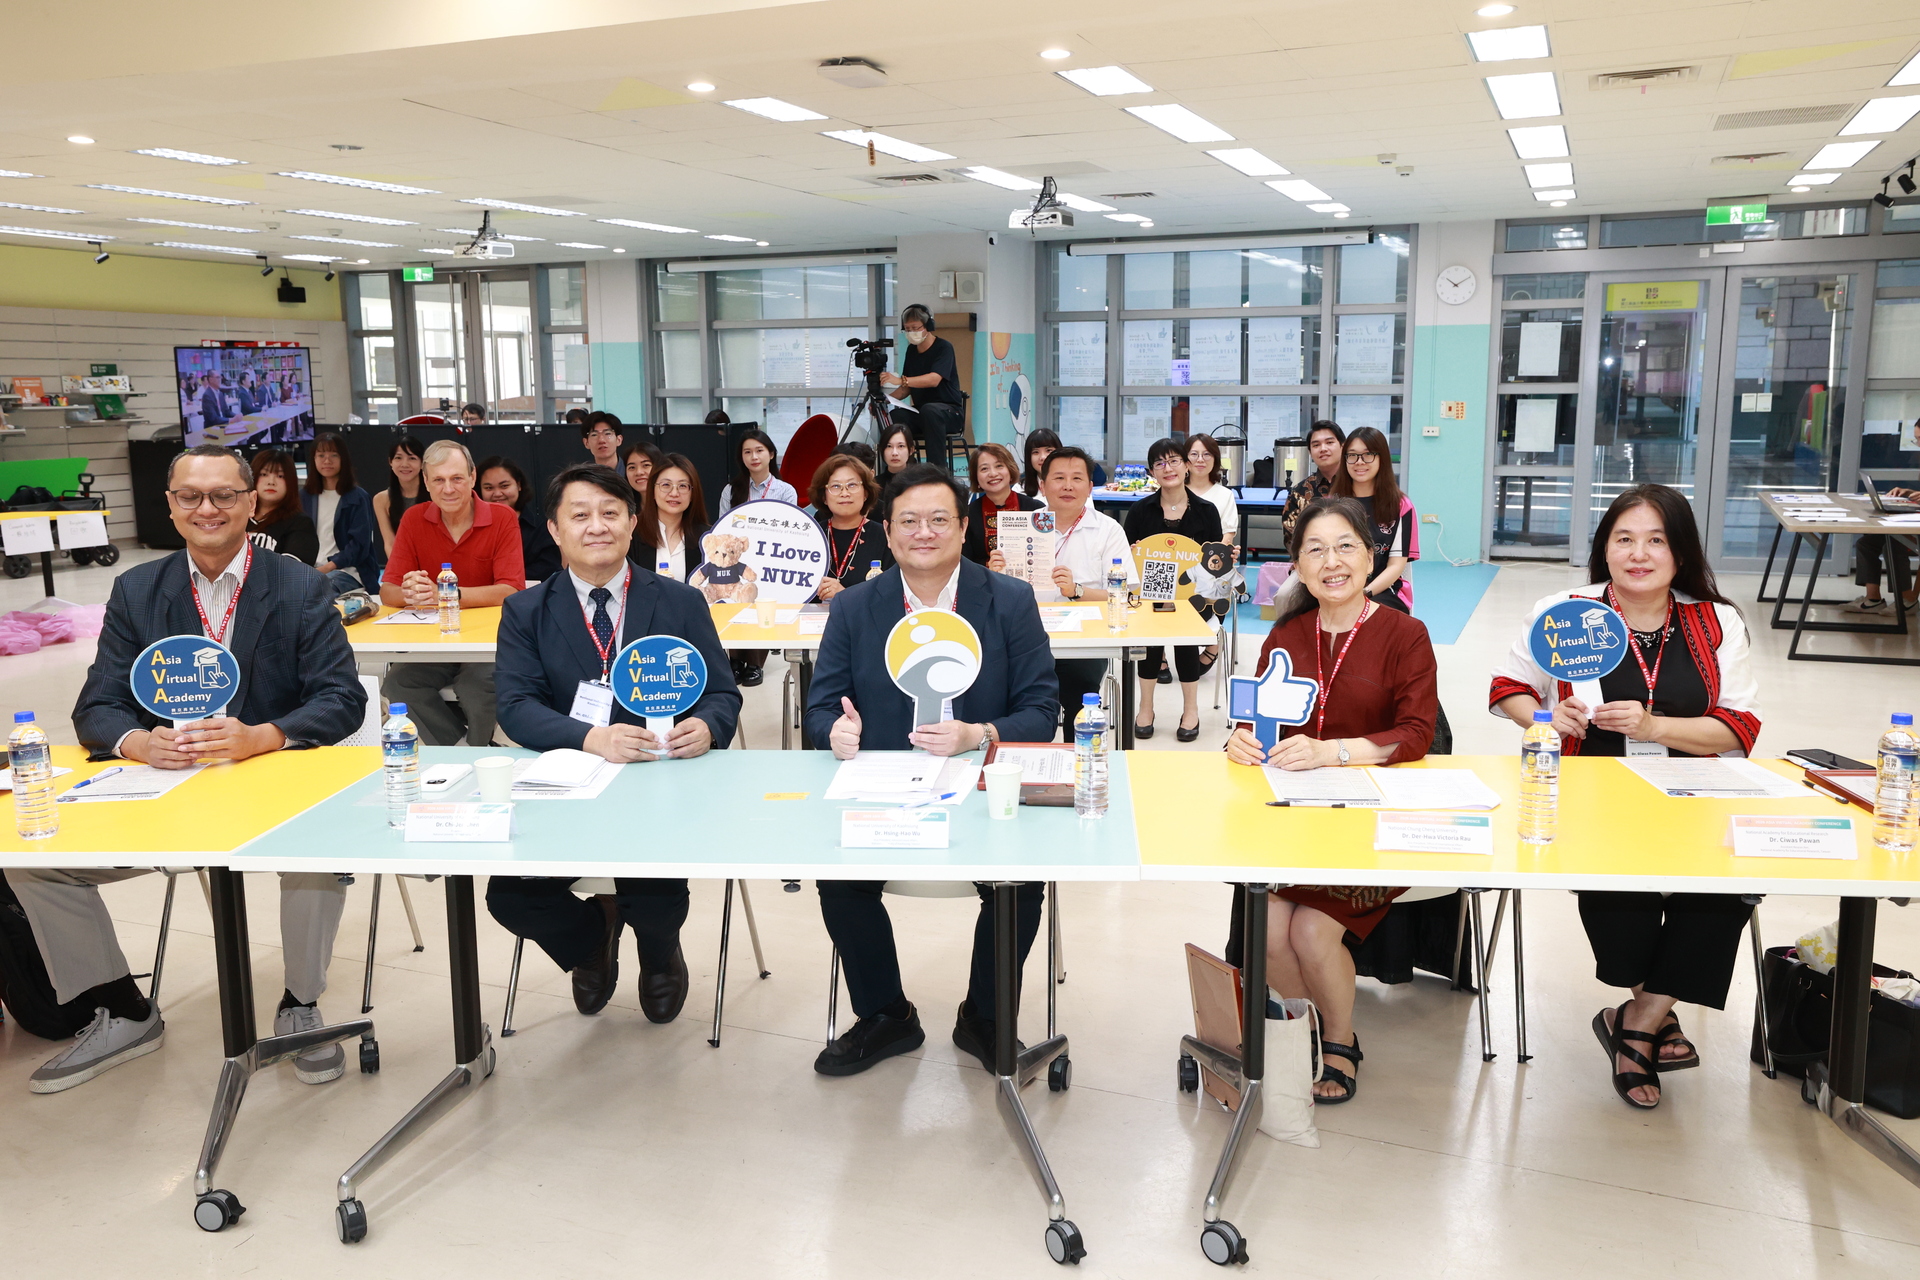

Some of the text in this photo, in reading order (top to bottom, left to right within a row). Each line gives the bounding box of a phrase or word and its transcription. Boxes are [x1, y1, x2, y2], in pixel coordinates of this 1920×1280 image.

[756, 541, 821, 562] I Love
[1136, 547, 1199, 561] I Love NUK
[760, 567, 814, 587] NUK
[1544, 615, 1571, 630] Asia
[1545, 633, 1588, 648] Virtual
[151, 650, 181, 665] Asia
[628, 650, 656, 664] Asia
[1550, 652, 1603, 667] Academy
[151, 669, 197, 684] Virtual
[628, 668, 669, 683] Virtual
[154, 688, 211, 703] Academy
[630, 687, 681, 702] Academy
